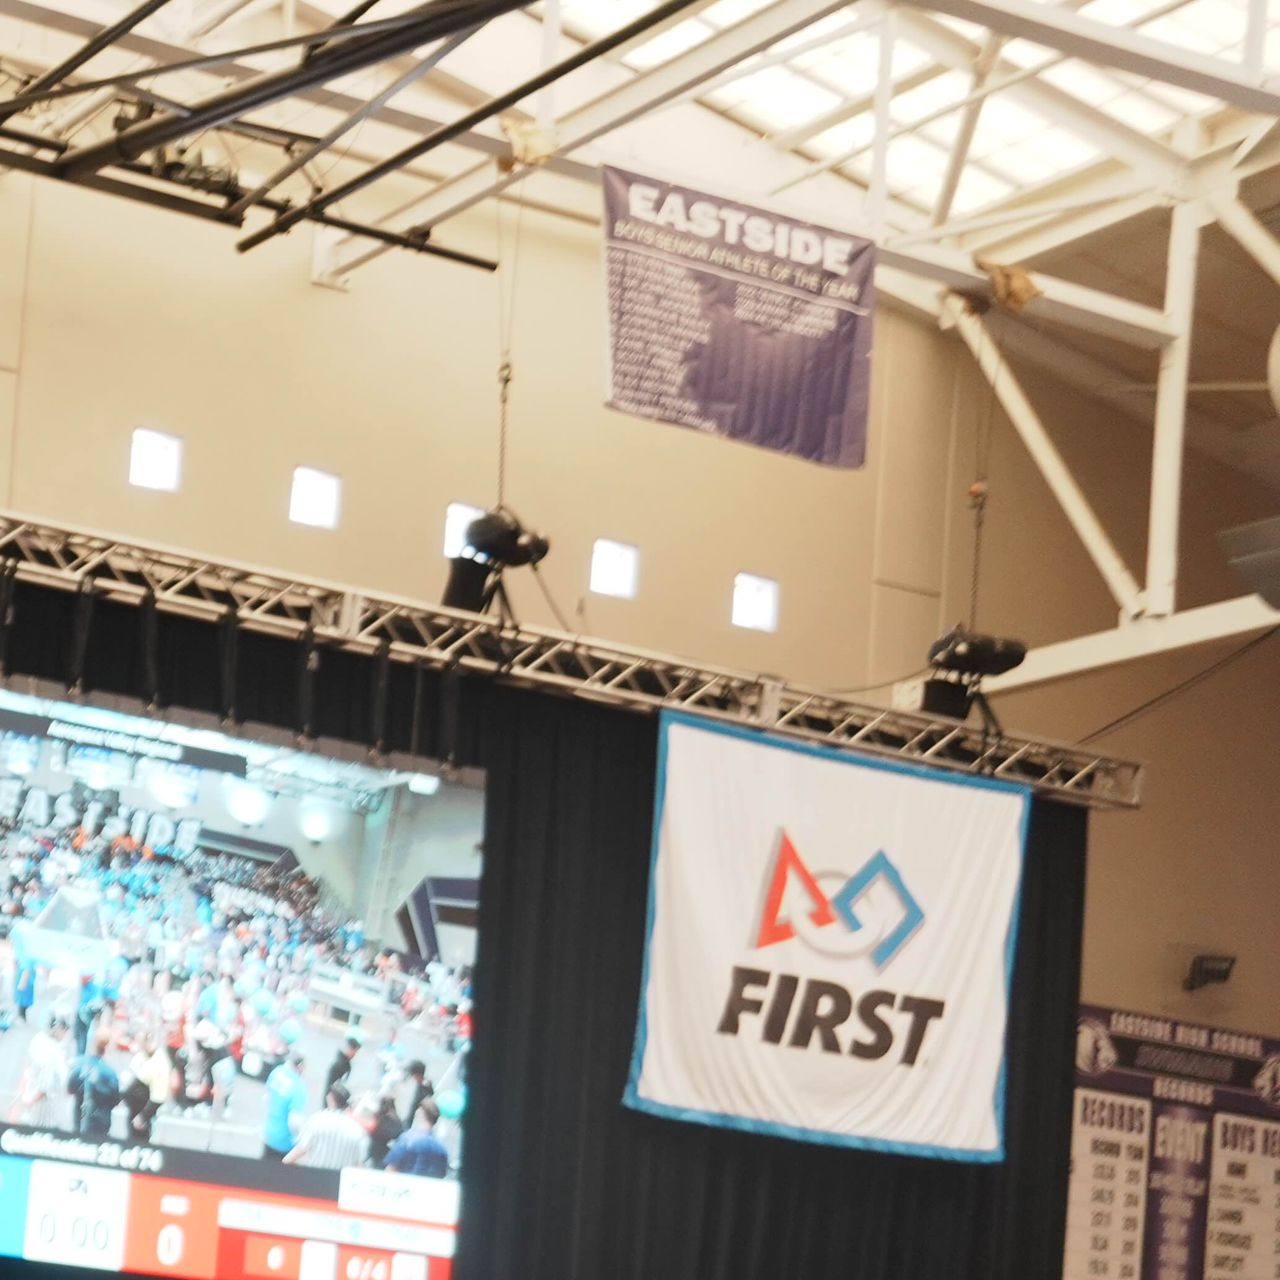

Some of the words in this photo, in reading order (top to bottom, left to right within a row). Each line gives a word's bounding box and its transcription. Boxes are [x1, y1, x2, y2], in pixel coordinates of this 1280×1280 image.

[627, 183, 853, 276] EASTSIDE
[709, 246, 770, 278] ATHLETE
[771, 262, 790, 282] OF
[793, 266, 820, 291] THE
[820, 277, 859, 302] YEAR
[716, 967, 945, 1067] FIRST
[1081, 1098, 1146, 1134] RECORDS
[1220, 1121, 1256, 1153] BOYS
[40, 1213, 109, 1251] 000
[157, 1224, 184, 1266] 0
